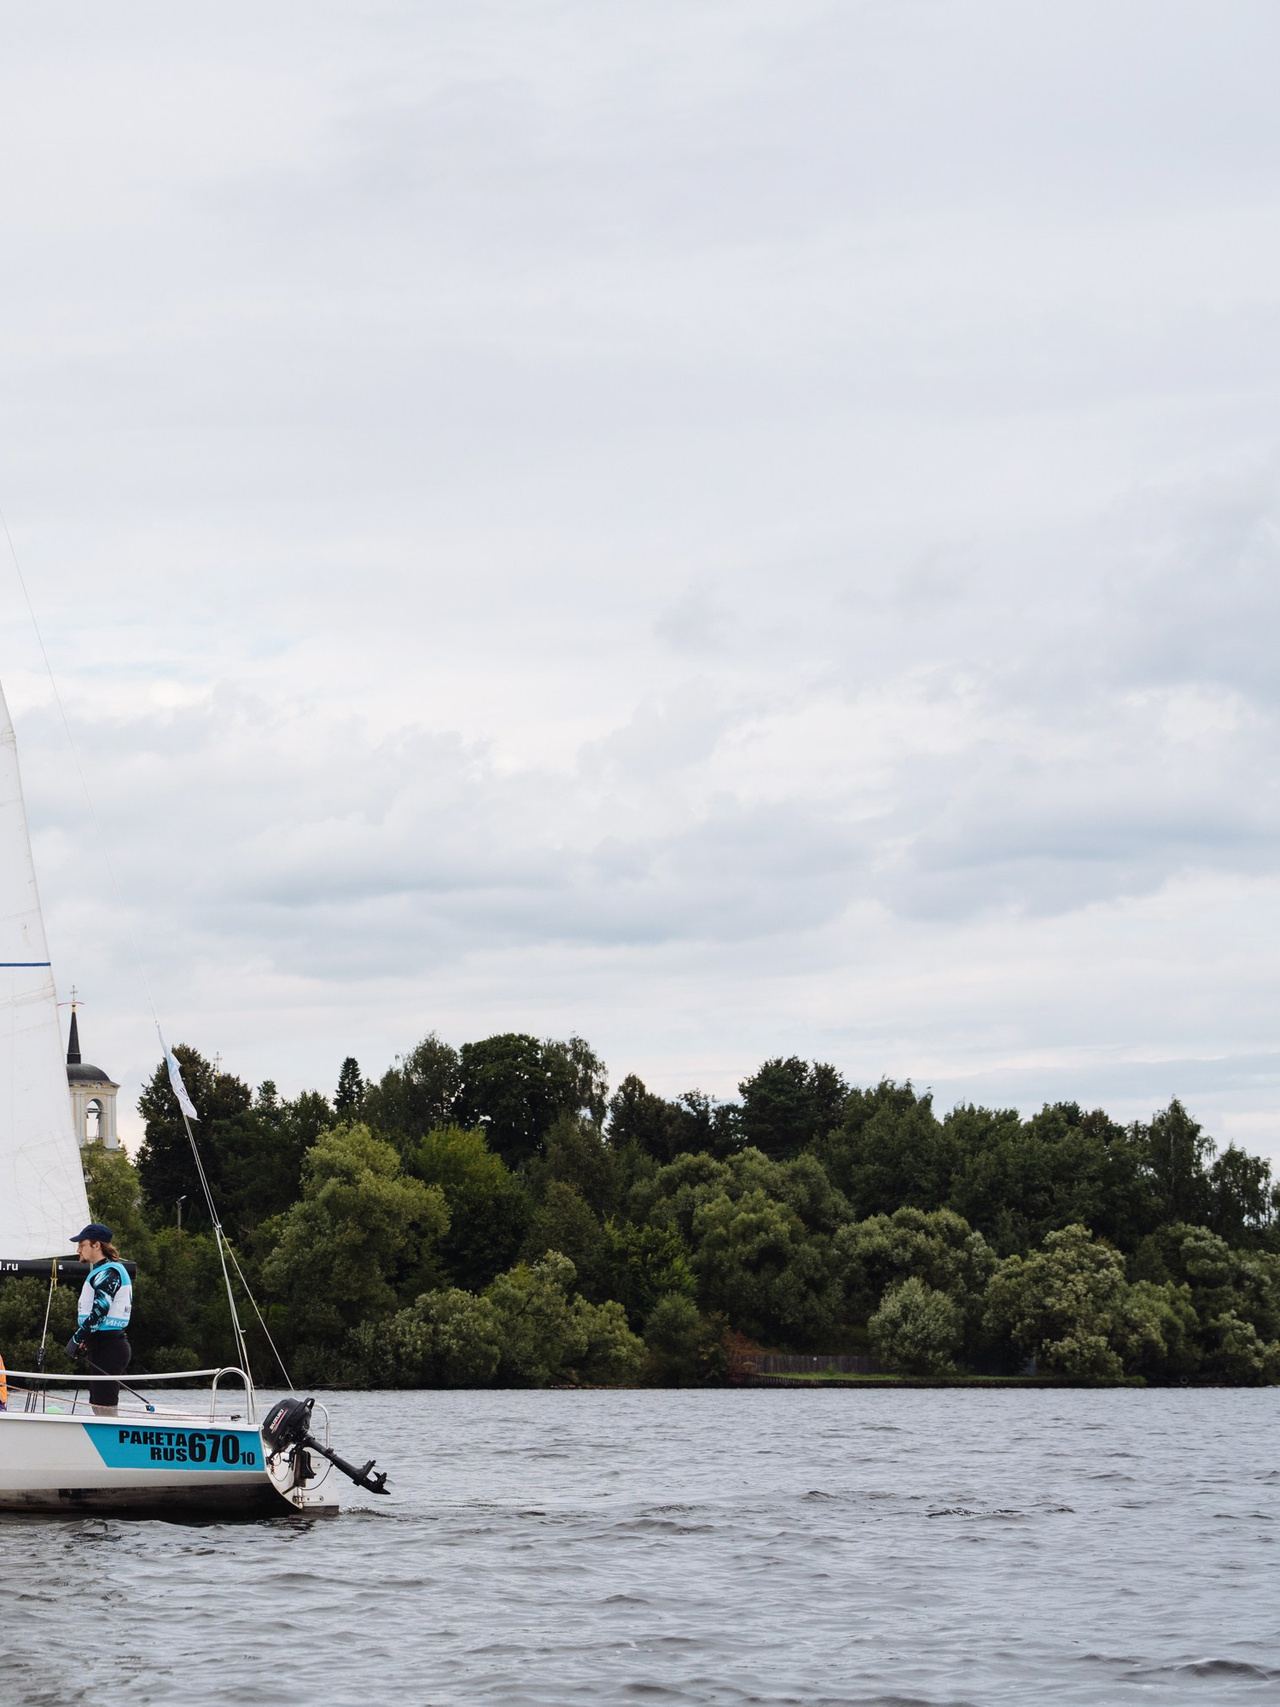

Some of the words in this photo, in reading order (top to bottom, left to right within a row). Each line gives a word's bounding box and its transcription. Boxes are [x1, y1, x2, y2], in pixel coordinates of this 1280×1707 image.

[150, 1447, 188, 1462] RUS
[188, 1433, 240, 1465] 670
[240, 1451, 255, 1466] 10
